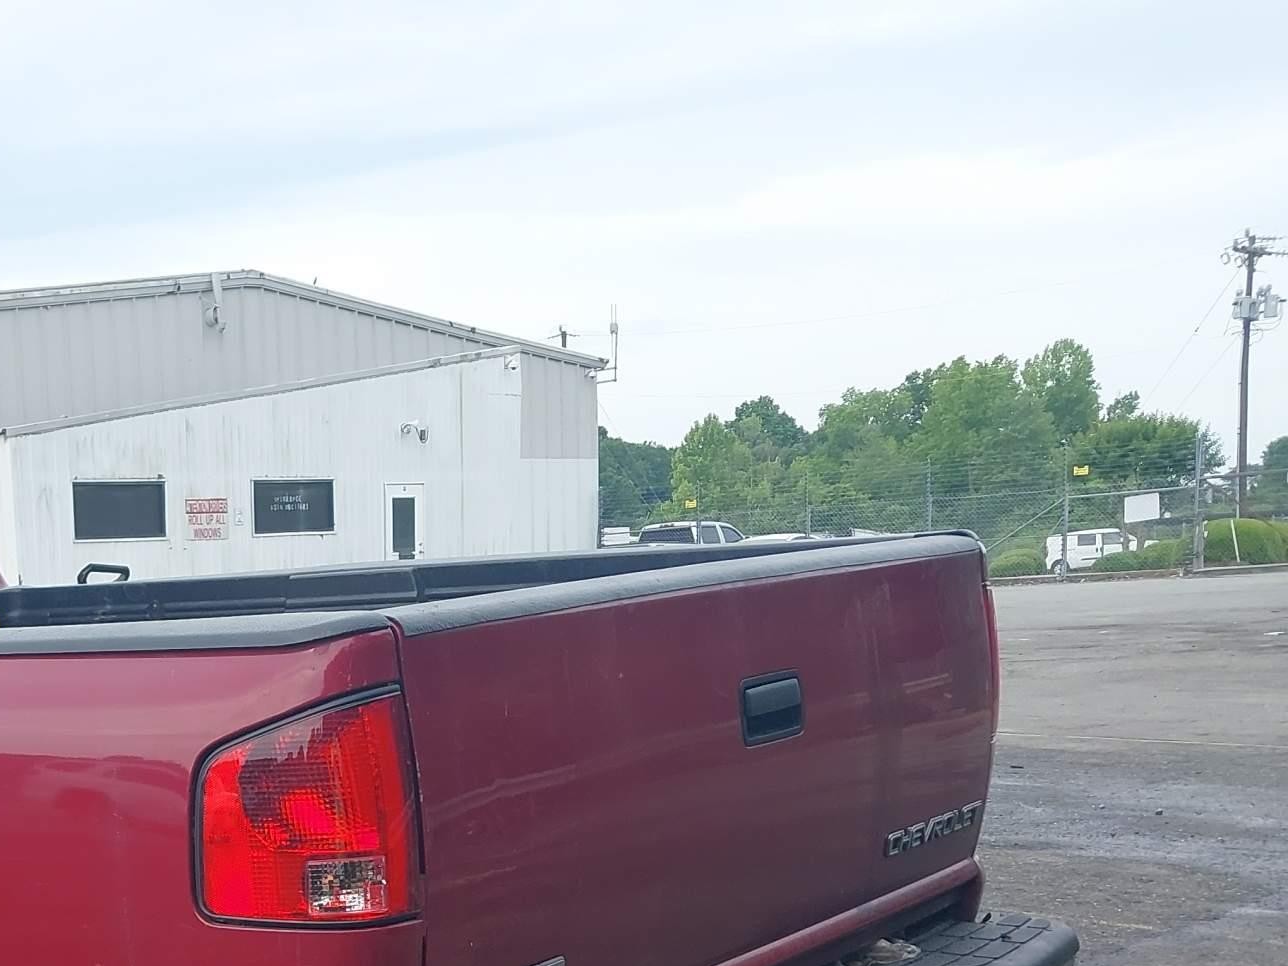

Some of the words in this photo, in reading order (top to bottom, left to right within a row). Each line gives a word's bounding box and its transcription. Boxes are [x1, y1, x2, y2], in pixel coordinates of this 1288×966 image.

[188, 514, 203, 526] ROLL
[206, 514, 214, 525] UP
[215, 514, 226, 525] ALL
[193, 527, 222, 539] WINDOWS
[886, 799, 983, 856] CHEVROLET
